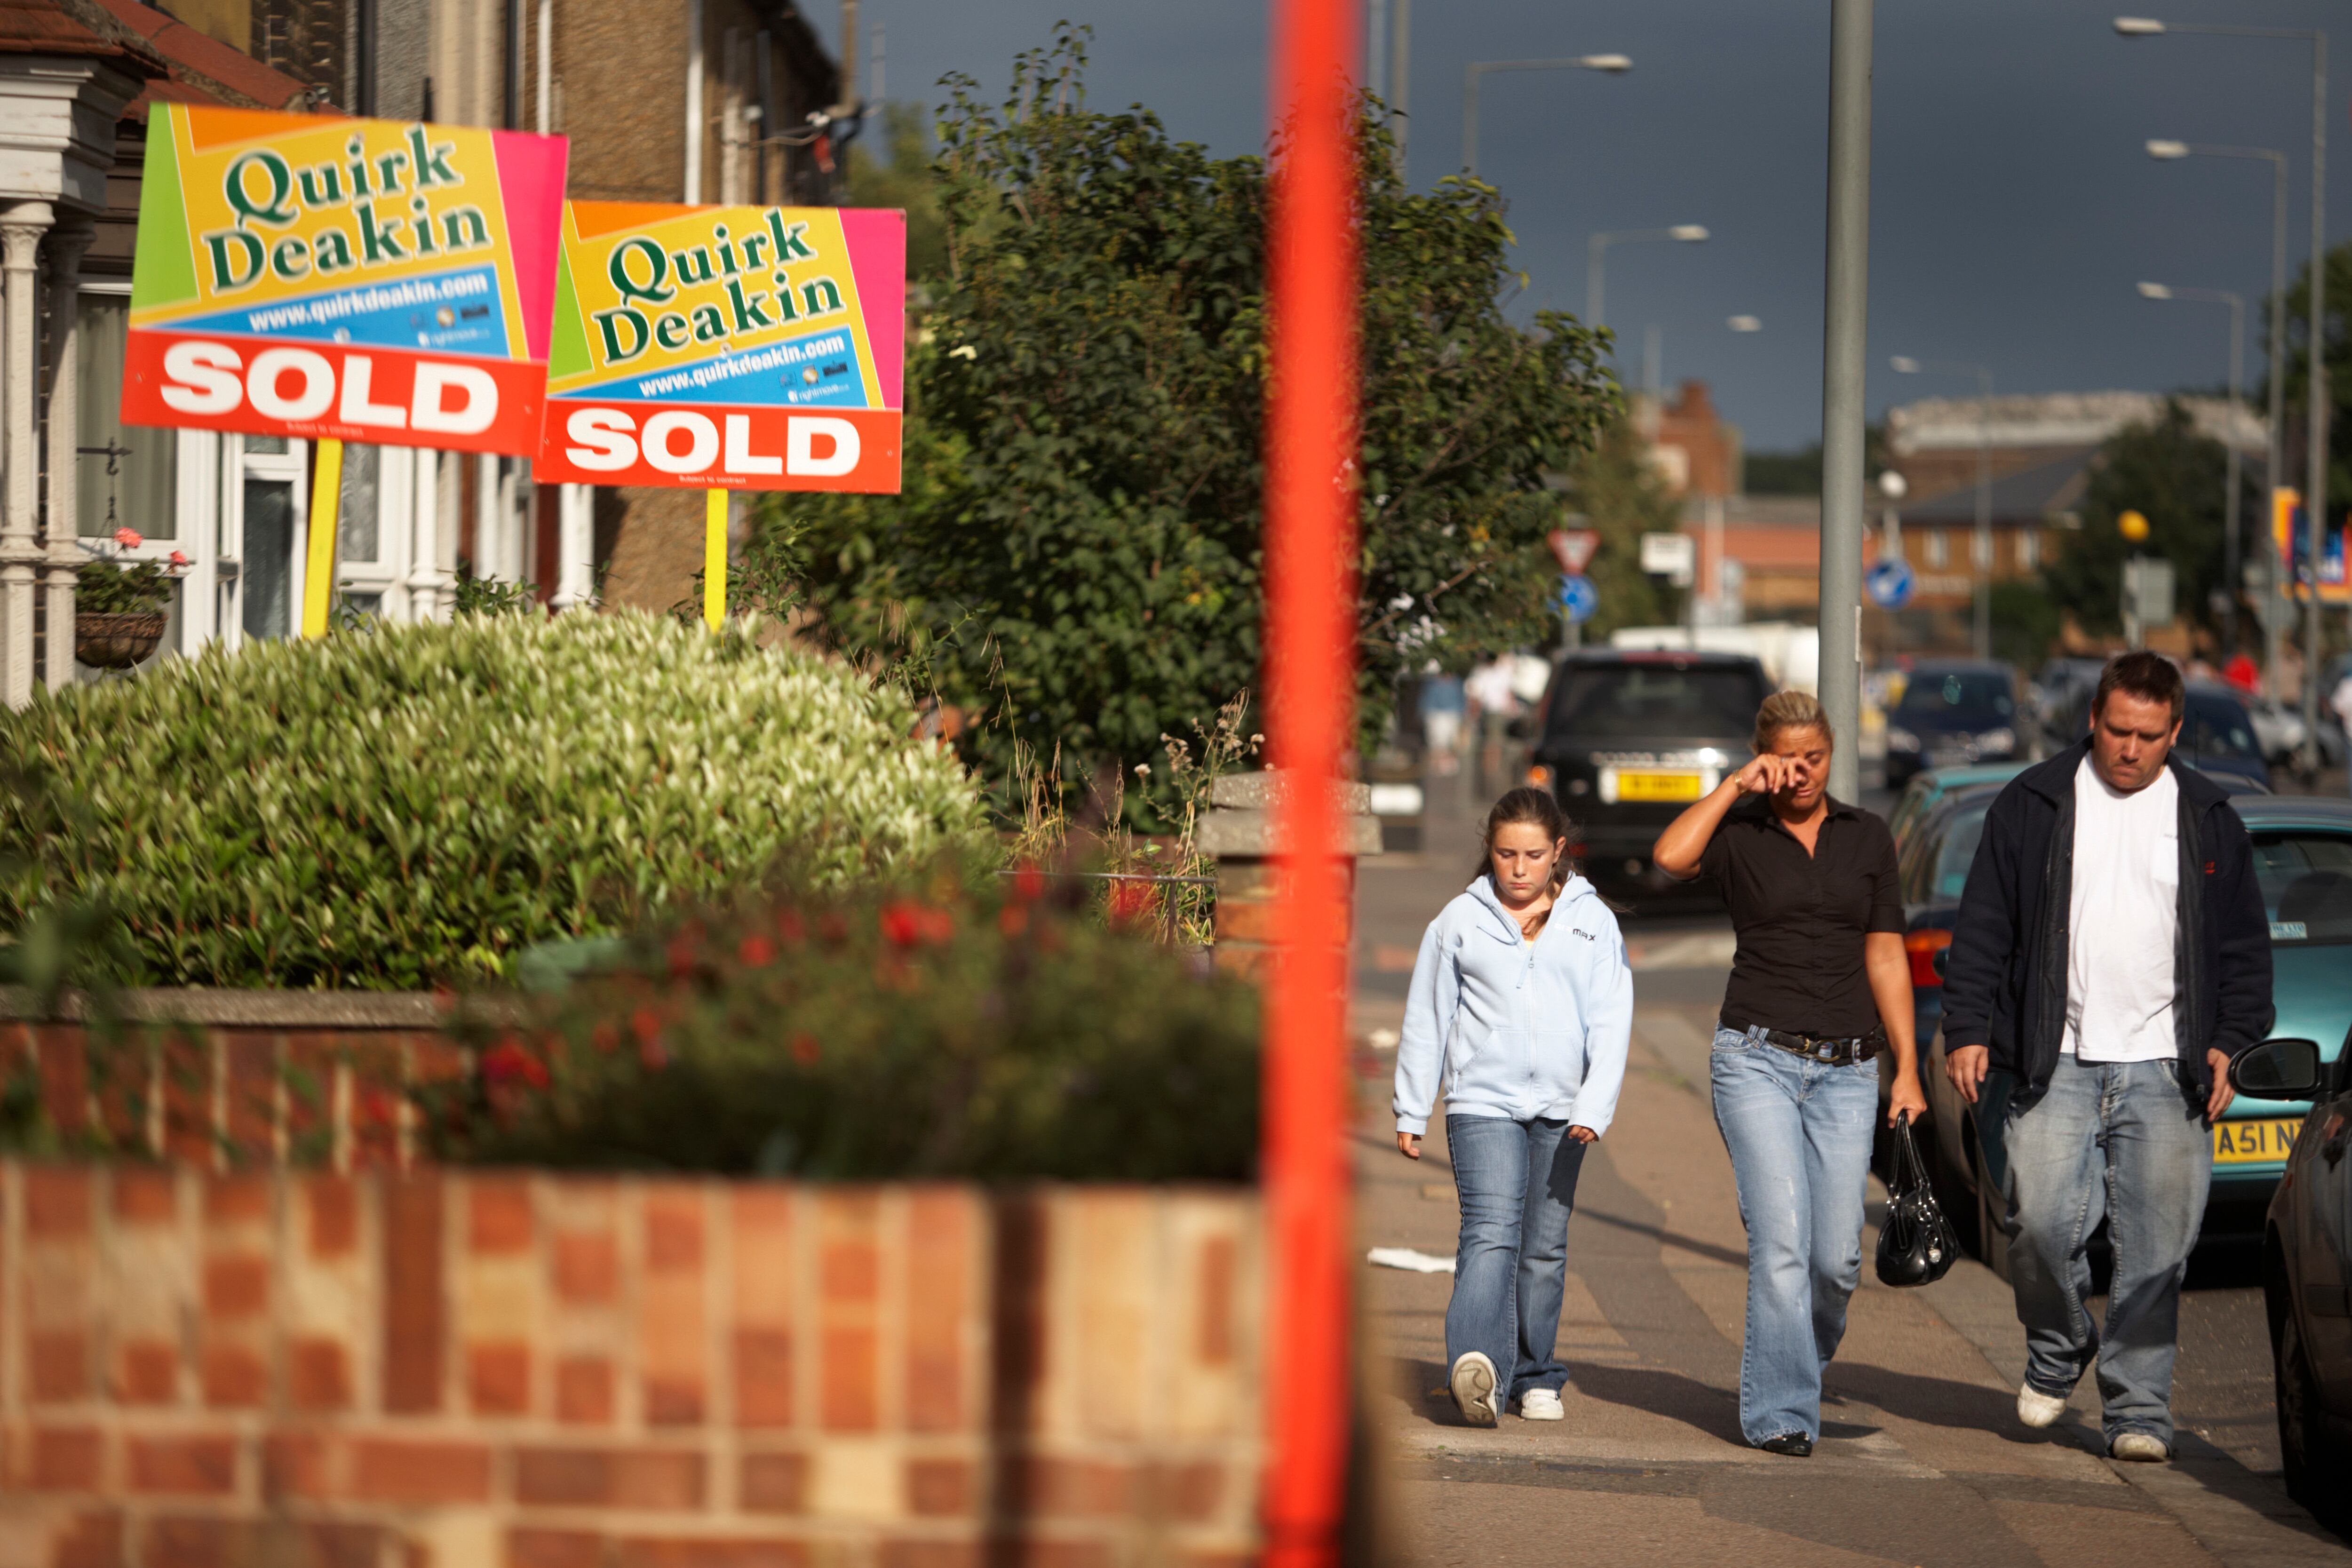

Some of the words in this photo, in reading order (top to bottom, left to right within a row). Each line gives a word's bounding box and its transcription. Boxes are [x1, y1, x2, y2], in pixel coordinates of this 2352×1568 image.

[223, 121, 462, 231] Quirk
[202, 196, 492, 294] Deakin
[608, 207, 817, 307] Quirk
[248, 273, 488, 332] www.quirkdeakin.com
[591, 270, 846, 365] Deakin
[160, 341, 499, 435] SOLD
[638, 335, 845, 397] www.quirkdeakin.com
[565, 407, 860, 476] SOLD
[2275, 1122, 2304, 1152] N
